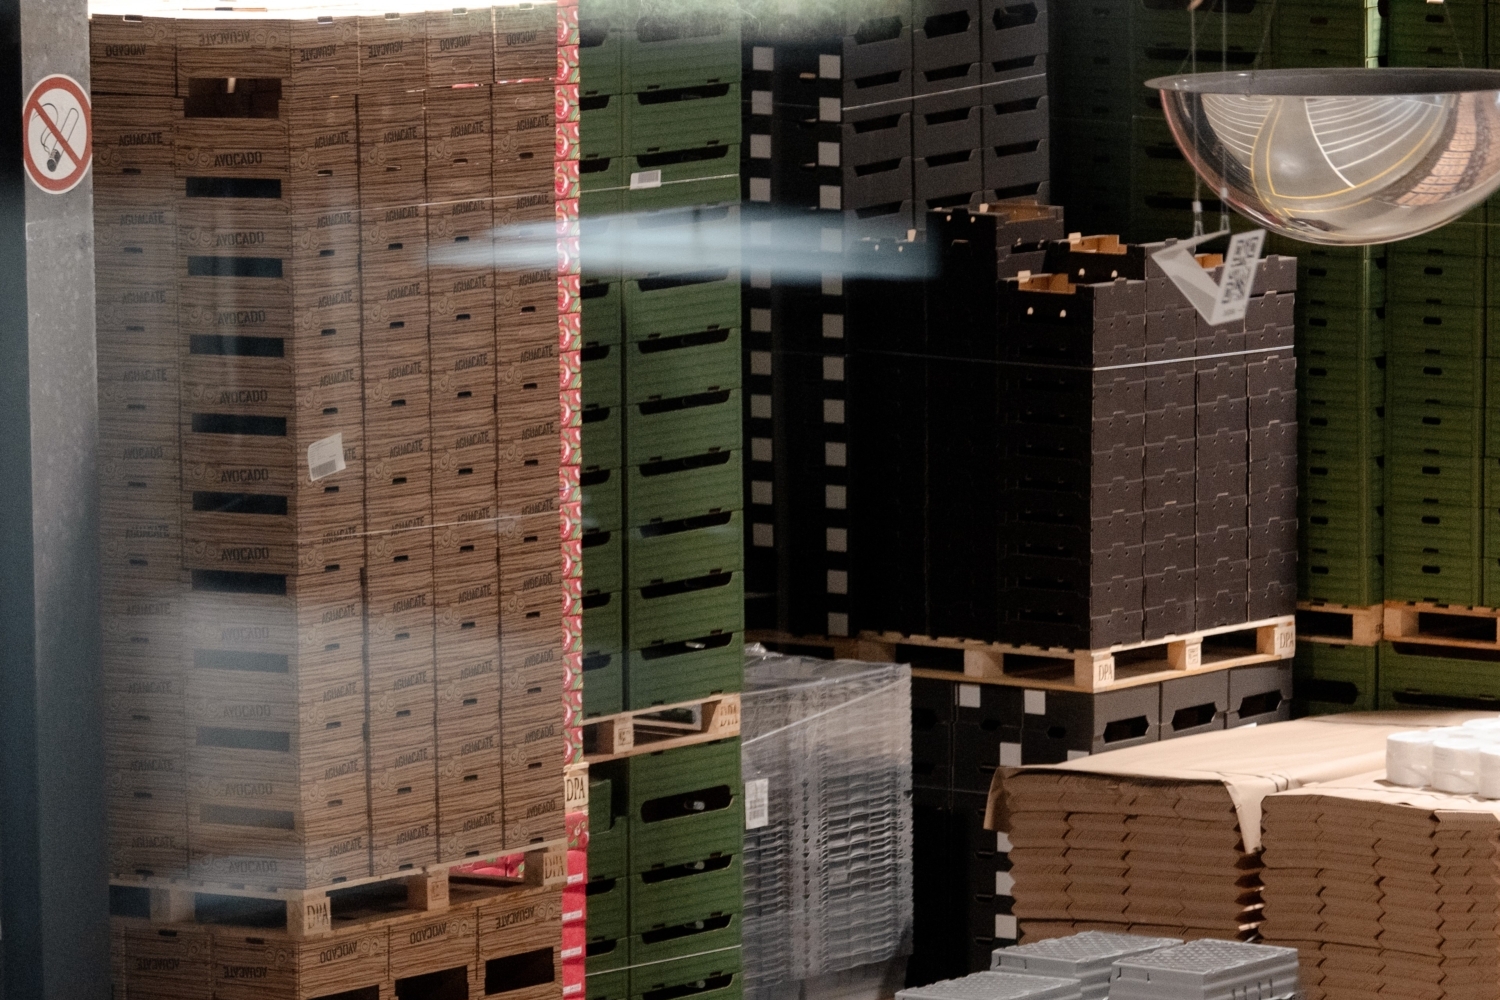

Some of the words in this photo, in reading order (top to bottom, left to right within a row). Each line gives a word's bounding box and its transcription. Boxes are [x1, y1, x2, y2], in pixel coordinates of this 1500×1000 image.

[118, 132, 162, 147] AGUACATE
[214, 151, 262, 167] AVOCADO
[216, 231, 264, 246] AVOCADO
[453, 276, 486, 293] AGUACATE
[519, 269, 551, 287] AGUACATE
[318, 290, 352, 309] AGUACATE
[387, 283, 421, 301] AGUACATE
[218, 310, 266, 325] AVOCADO
[455, 354, 488, 371] AGUACATE
[521, 345, 553, 363] AGUACATE
[320, 369, 354, 387] AGUACATE
[388, 362, 422, 379] AGUACATE
[220, 389, 268, 404] AVOCADO
[456, 431, 489, 450] AGUACATE
[522, 422, 554, 440] AGUACATE
[390, 440, 423, 458] AGUACATE
[221, 469, 269, 483] AVOCADO
[221, 547, 269, 562] AVOCADO
[459, 584, 492, 603] AGUACATE
[393, 594, 426, 613] AGUACATE
[322, 604, 355, 624] AGUACATE
[1280, 631, 1295, 649] DPA
[461, 660, 493, 680] AGUACATE
[1099, 664, 1113, 681] DPA
[393, 671, 427, 690] AGUACATE
[461, 736, 493, 756] AGUACATE
[395, 748, 428, 768] AGUACATE
[325, 760, 358, 780] AGUACATE
[567, 776, 585, 802] DPA
[463, 812, 495, 832] AGUACATE
[397, 825, 429, 845] AGUACATE
[329, 837, 362, 858] AGUACATE
[544, 855, 565, 878] DPA
[307, 903, 330, 929] DPA
[496, 905, 535, 929] AGUACATE
[410, 922, 447, 944] AVOCADO
[320, 941, 357, 964] AVOCADO
